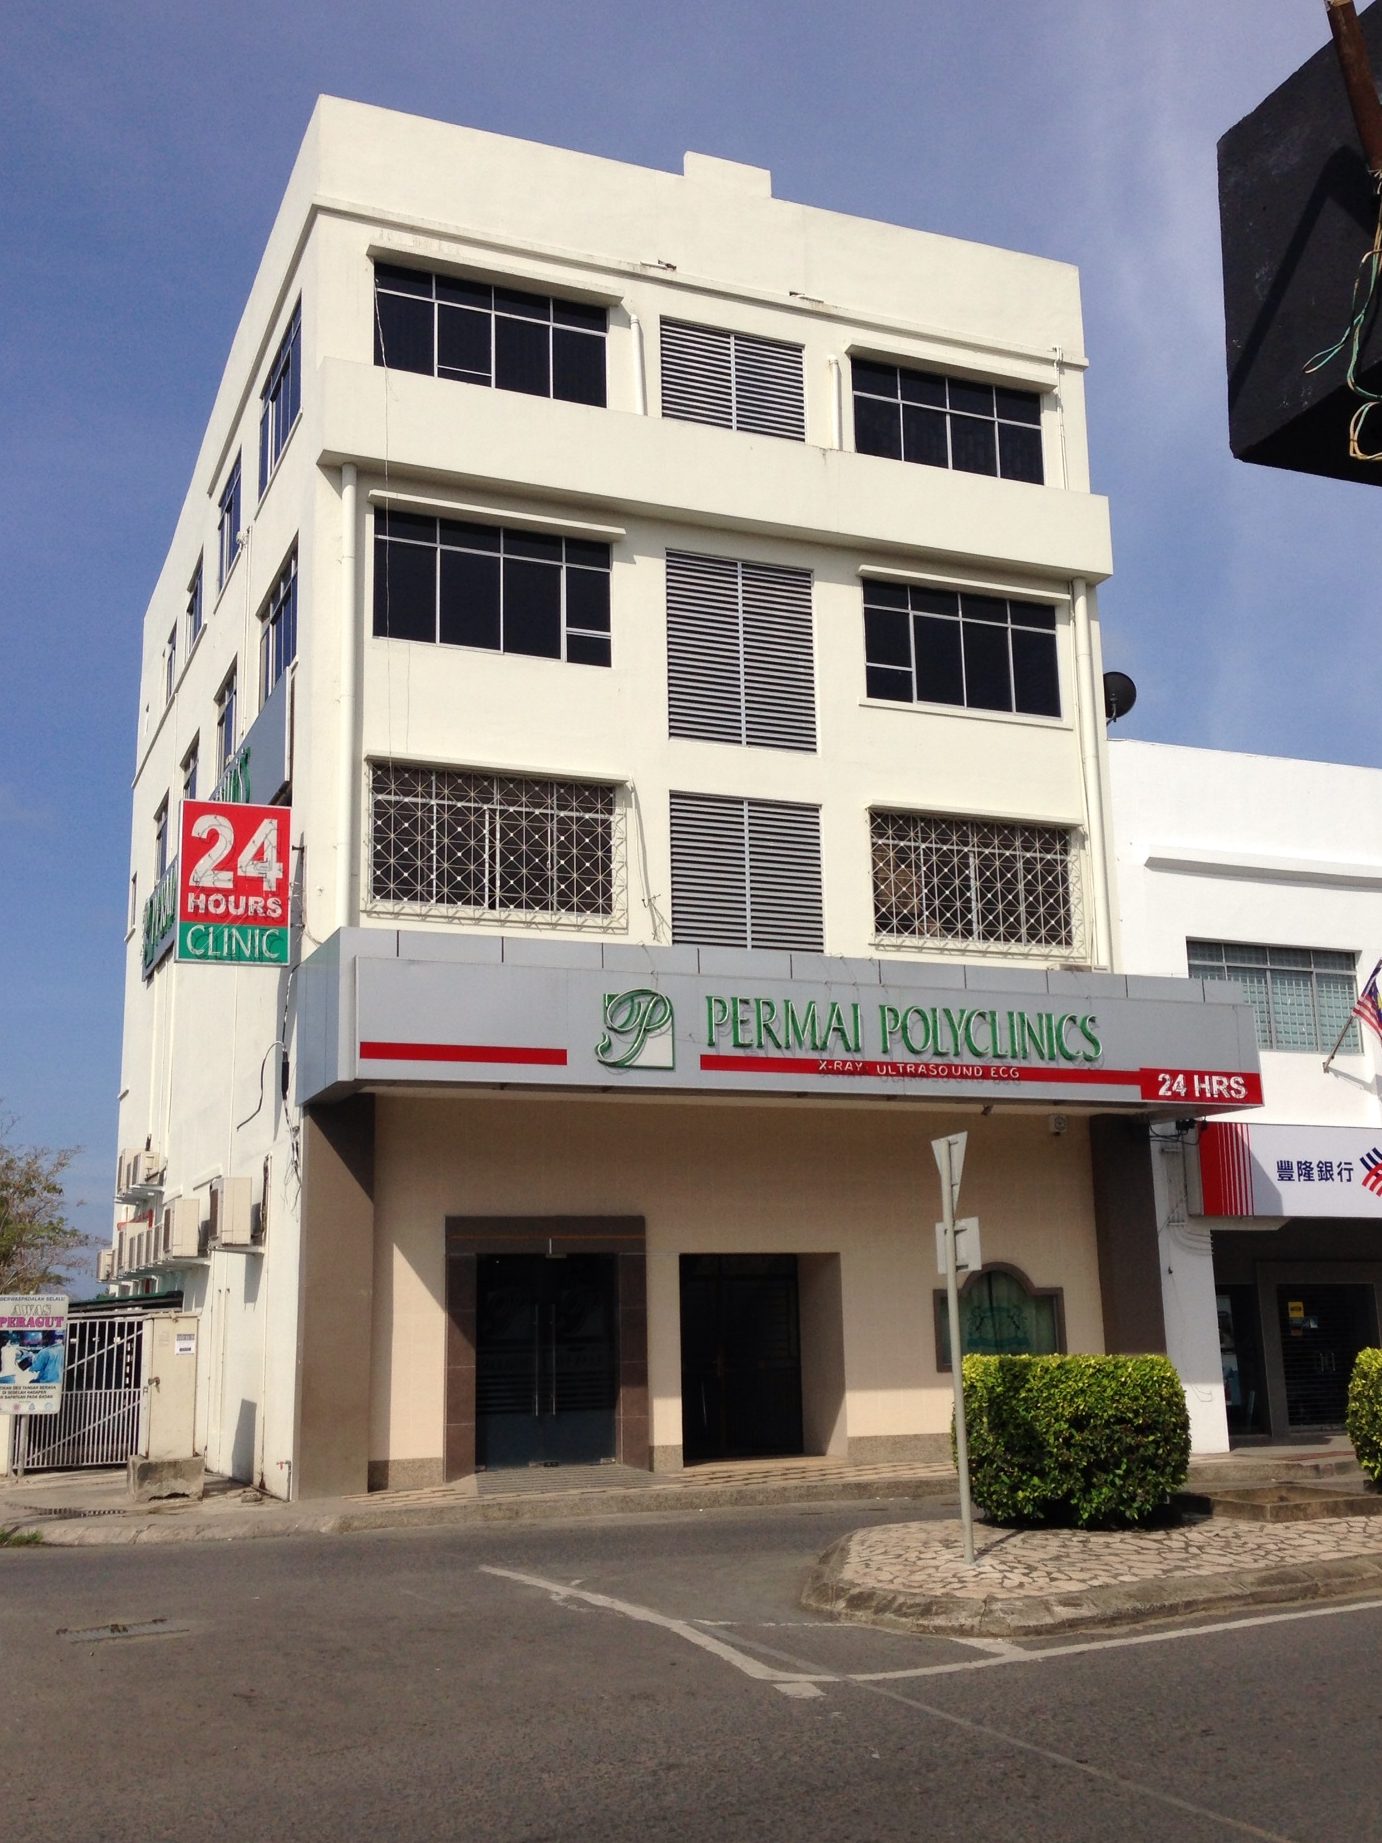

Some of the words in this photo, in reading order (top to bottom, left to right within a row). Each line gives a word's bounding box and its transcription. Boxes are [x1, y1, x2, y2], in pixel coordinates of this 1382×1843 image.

[189, 814, 283, 891] 24
[187, 891, 282, 918] HOURS
[186, 925, 280, 958] CLINIC
[705, 995, 861, 1053] PERMAI
[878, 1003, 1103, 1062] POLYCLINICS
[818, 1059, 863, 1072] X-RAY
[876, 1063, 983, 1078] ULTRASOUND
[990, 1066, 1020, 1079] ECG
[1157, 1073, 1188, 1097] 24
[1193, 1074, 1249, 1099] HRS
[1276, 1159, 1355, 1183] 豐隆銀行
[0, 1316, 65, 1328] PERAGUT
[11, 1304, 52, 1316] AWAS
